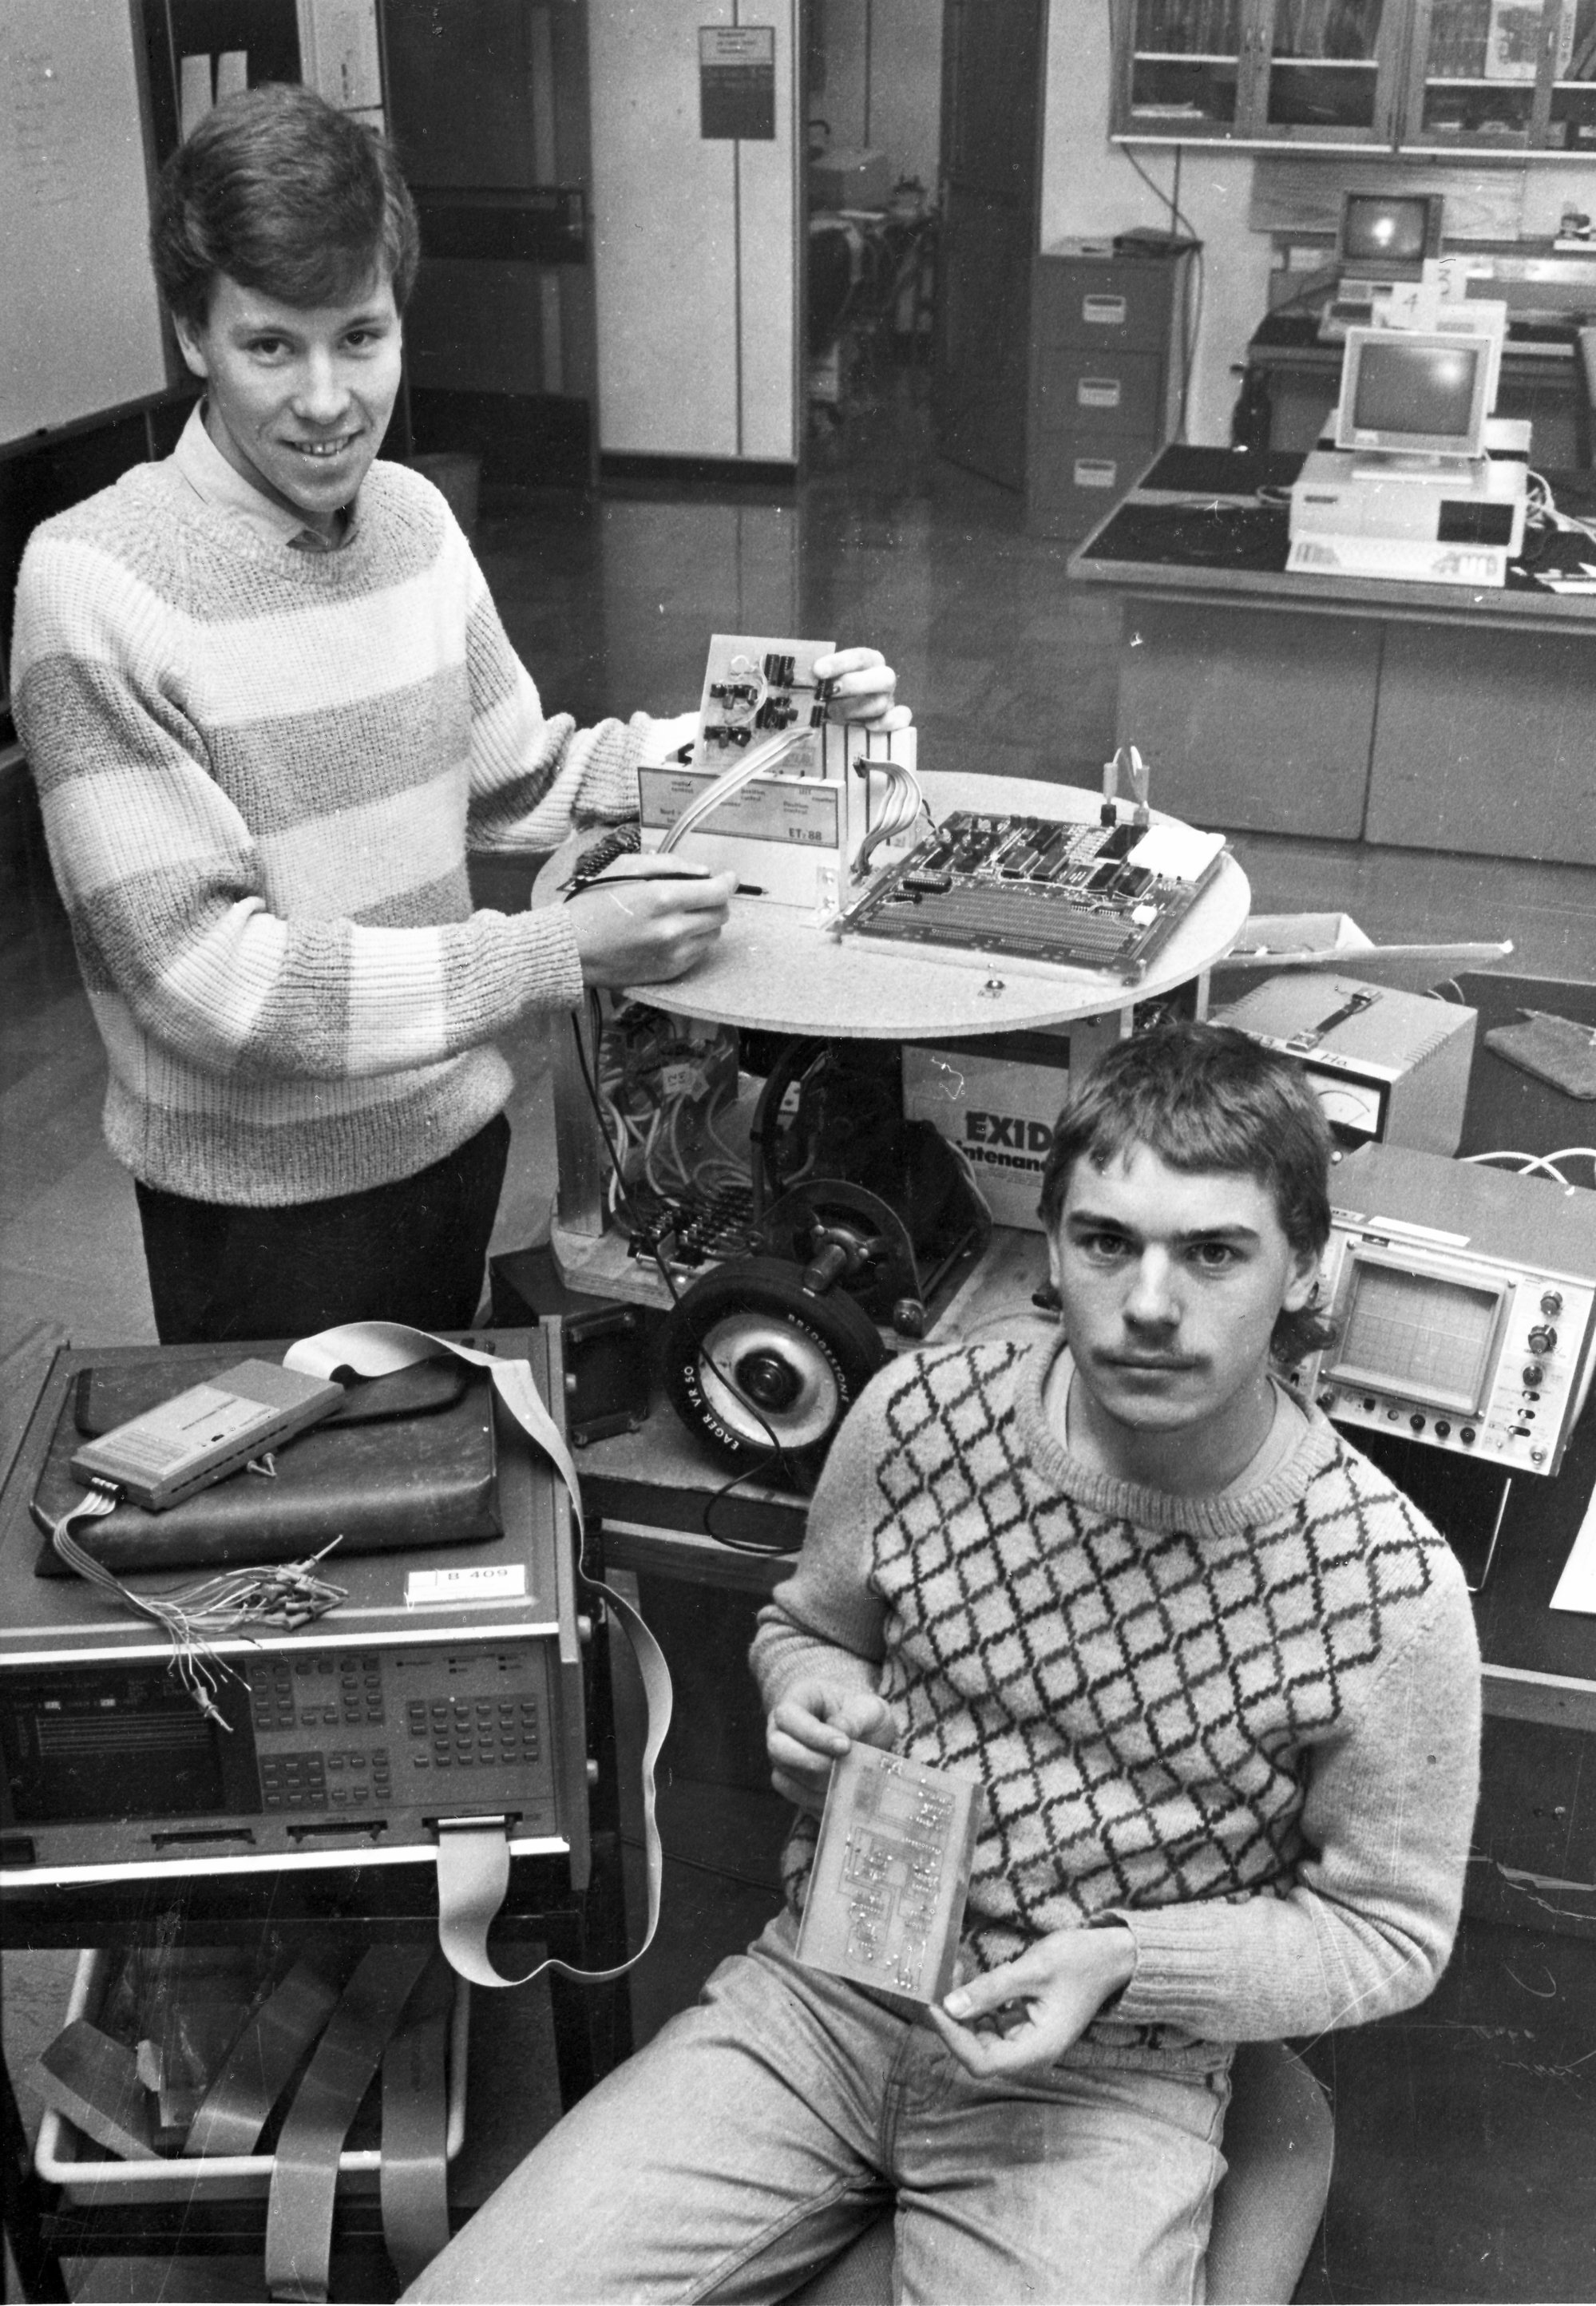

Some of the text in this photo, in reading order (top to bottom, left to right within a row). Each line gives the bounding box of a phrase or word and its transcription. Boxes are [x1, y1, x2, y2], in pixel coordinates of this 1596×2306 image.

[965, 1110, 1054, 1153] EXID
[956, 1139, 1047, 1172] ntenan
[787, 1313, 849, 1403] BRIDGESTONE
[703, 1413, 740, 1451] EAGER
[469, 1568, 509, 1579] 409
